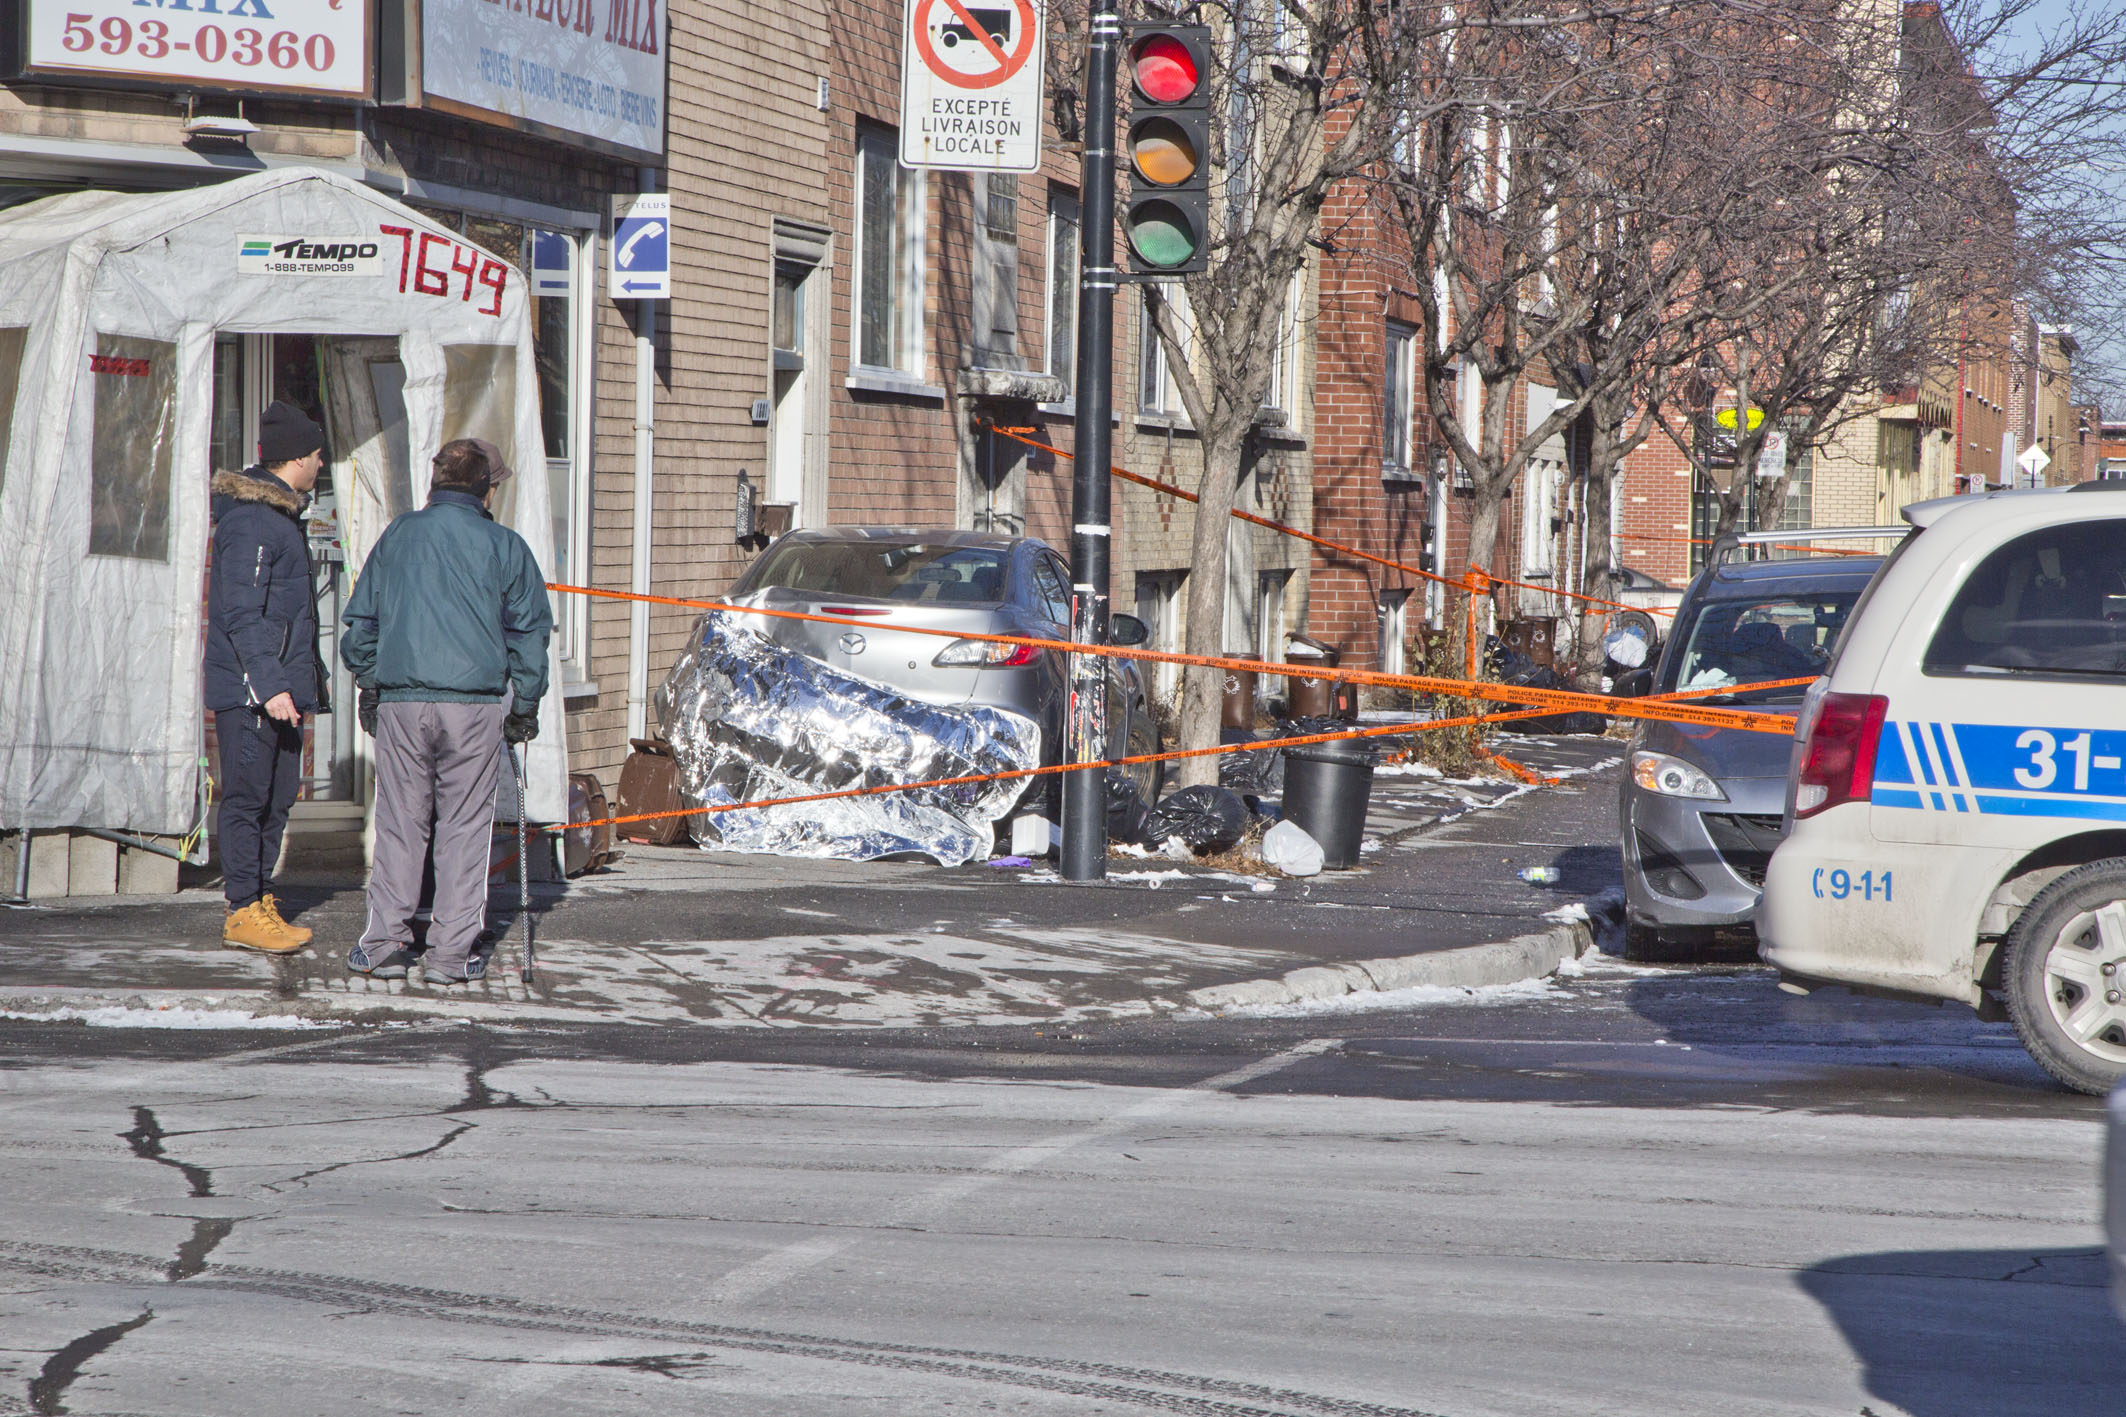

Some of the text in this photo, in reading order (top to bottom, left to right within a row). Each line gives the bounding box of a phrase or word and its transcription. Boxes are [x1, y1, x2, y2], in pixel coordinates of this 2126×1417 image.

[61, 12, 335, 72] 593-0360
[479, 47, 512, 88] REVUES
[518, 58, 557, 101] JOURNAUX
[597, 82, 616, 118] LOTO
[932, 97, 1011, 116] EXCEPTÉ
[922, 117, 1021, 136] LIVRAISON
[935, 137, 1006, 154] LOCALE
[273, 238, 378, 262] TEMPO
[264, 262, 355, 273] 1-888-TEMPO99
[379, 223, 509, 318] 7649
[1105, 650, 1198, 665] POLICE PASSAGE INTERDIT
[1265, 665, 1297, 674] PASSAGE
[1299, 669, 1332, 677] INTERDIT
[1399, 679, 1432, 687] PASSAGE
[1433, 682, 1466, 690] INTERDIT
[1744, 681, 1781, 689] INFO-CRIME
[1507, 689, 1533, 697] POLICE
[1534, 692, 1567, 700] PASSAGE
[1507, 695, 1548, 704] INFO-CRIME
[1643, 709, 1685, 719] INFO-CRIME
[1702, 716, 1734, 725] 393-1133
[1267, 738, 1304, 747] INFO-CRIME
[1144, 752, 1182, 761] INFO-CRIME
[2013, 729, 2126, 791] 31-
[1830, 868, 1893, 902] 9-1-1
